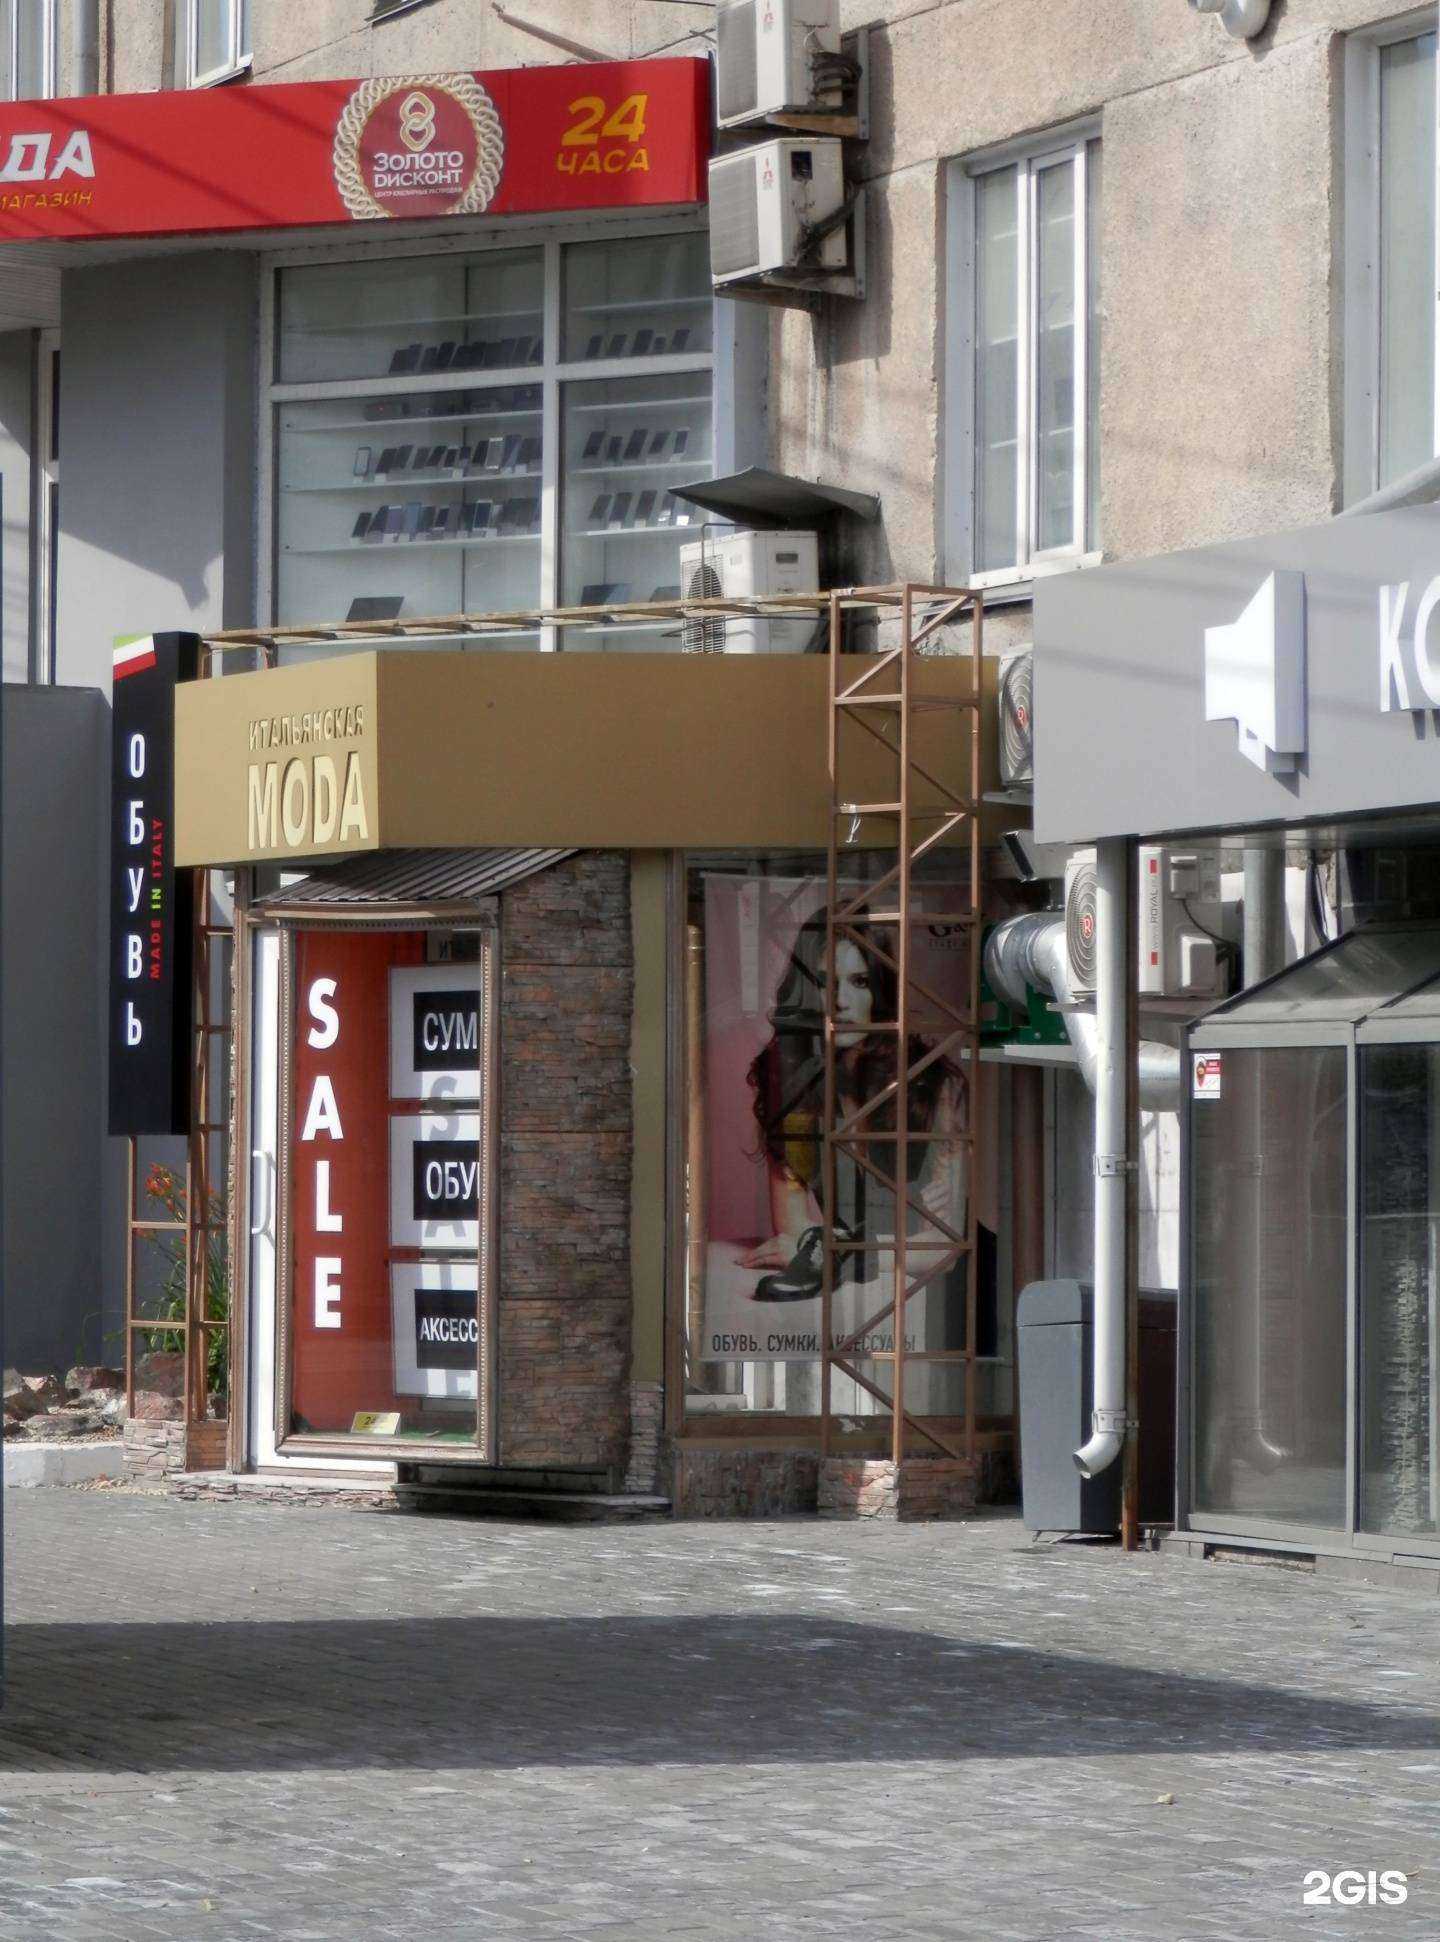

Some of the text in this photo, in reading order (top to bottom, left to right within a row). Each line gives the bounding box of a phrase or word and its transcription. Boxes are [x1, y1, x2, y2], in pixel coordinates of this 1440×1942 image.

[561, 94, 648, 147] 24
[373, 151, 464, 171] ЗОЛОТО
[556, 148, 649, 175] ЧАСА
[249, 705, 363, 750] ИТАЛЬЯНСКАЯ
[126, 733, 147, 1047] ОБУВЬ
[149, 819, 164, 980] MADE IN ITALY
[423, 1012, 478, 1051] СУМ
[302, 977, 344, 1329] SALE
[426, 1161, 479, 1200] ОБУ
[420, 1317, 478, 1342] АКСЕСС
[712, 1335, 762, 1352] ОБУВЬ.
[767, 1335, 820, 1352] СУМКИ.
